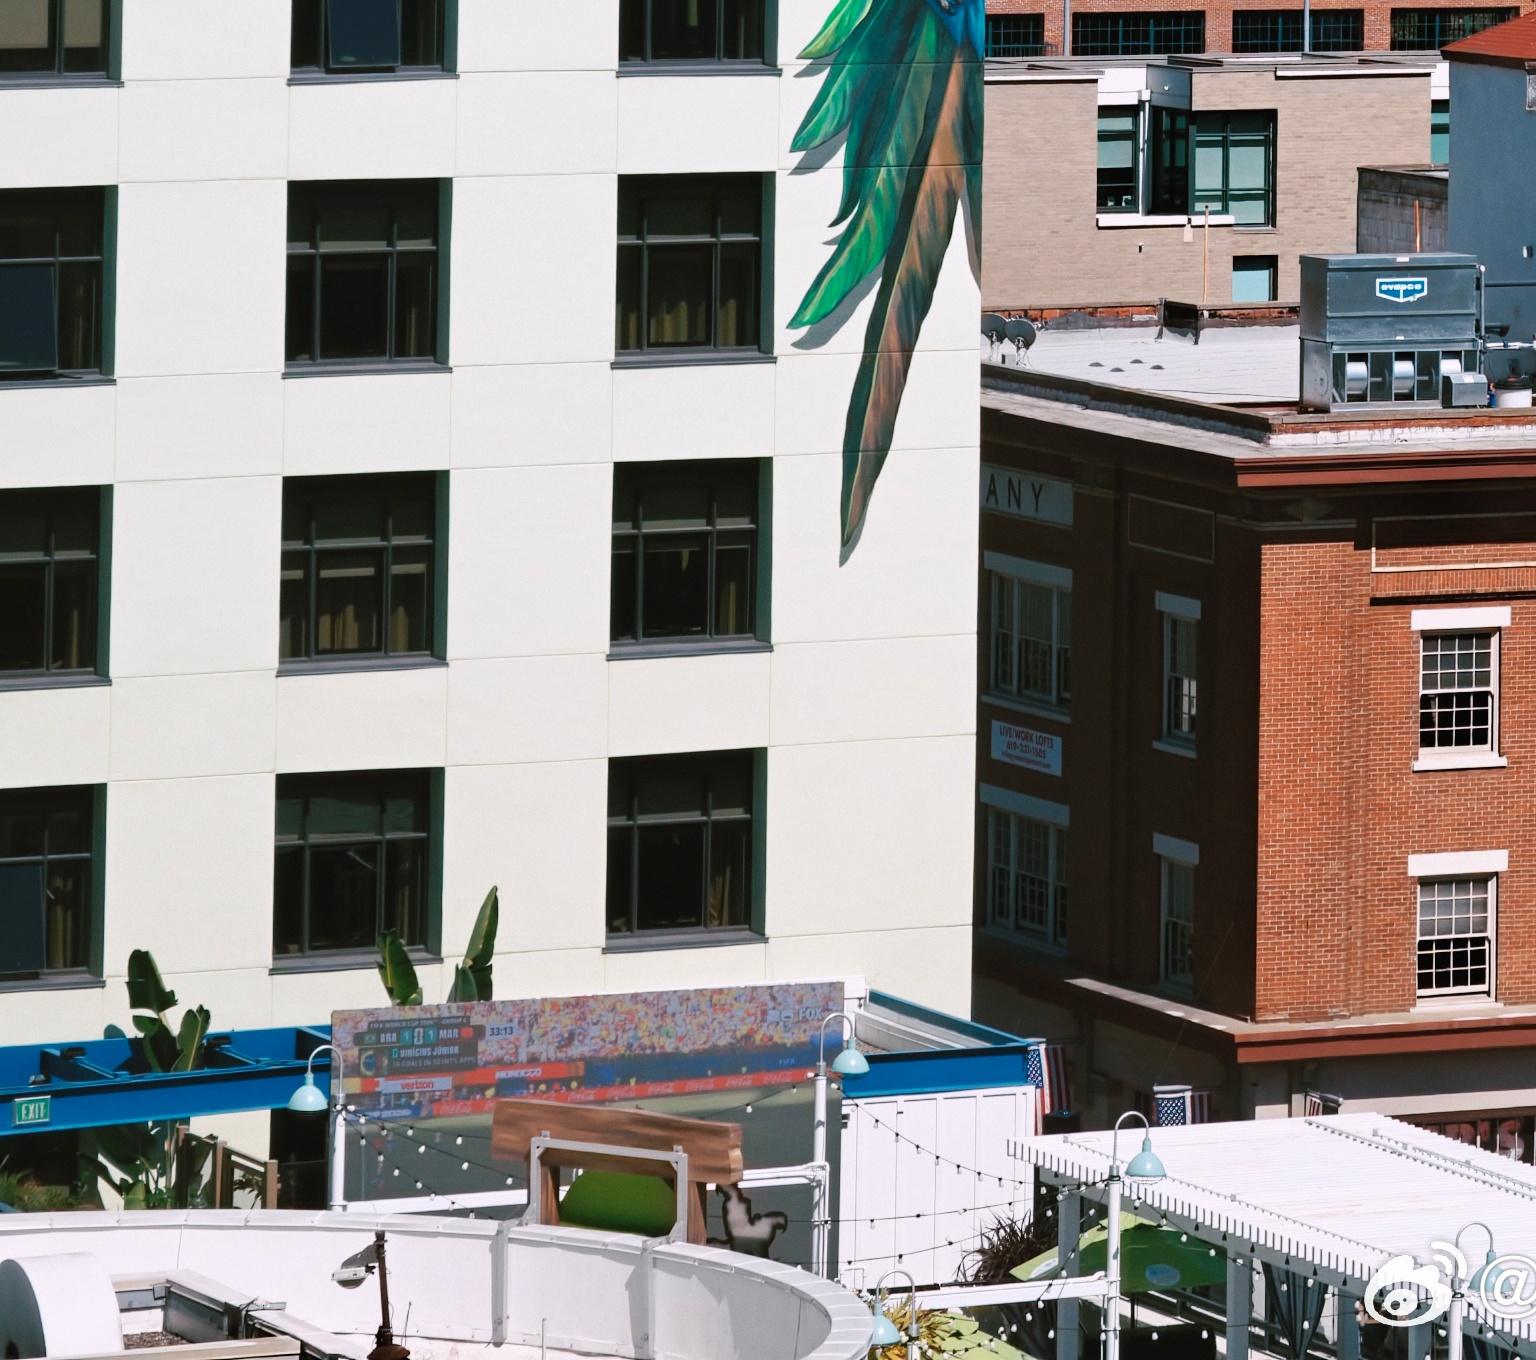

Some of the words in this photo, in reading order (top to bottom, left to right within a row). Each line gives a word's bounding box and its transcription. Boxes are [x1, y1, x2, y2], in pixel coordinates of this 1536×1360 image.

[985, 472, 1044, 513] ANY
[439, 1028, 459, 1040] MAR
[489, 1025, 514, 1037] 33:13
[22, 1102, 46, 1120] EXIT
